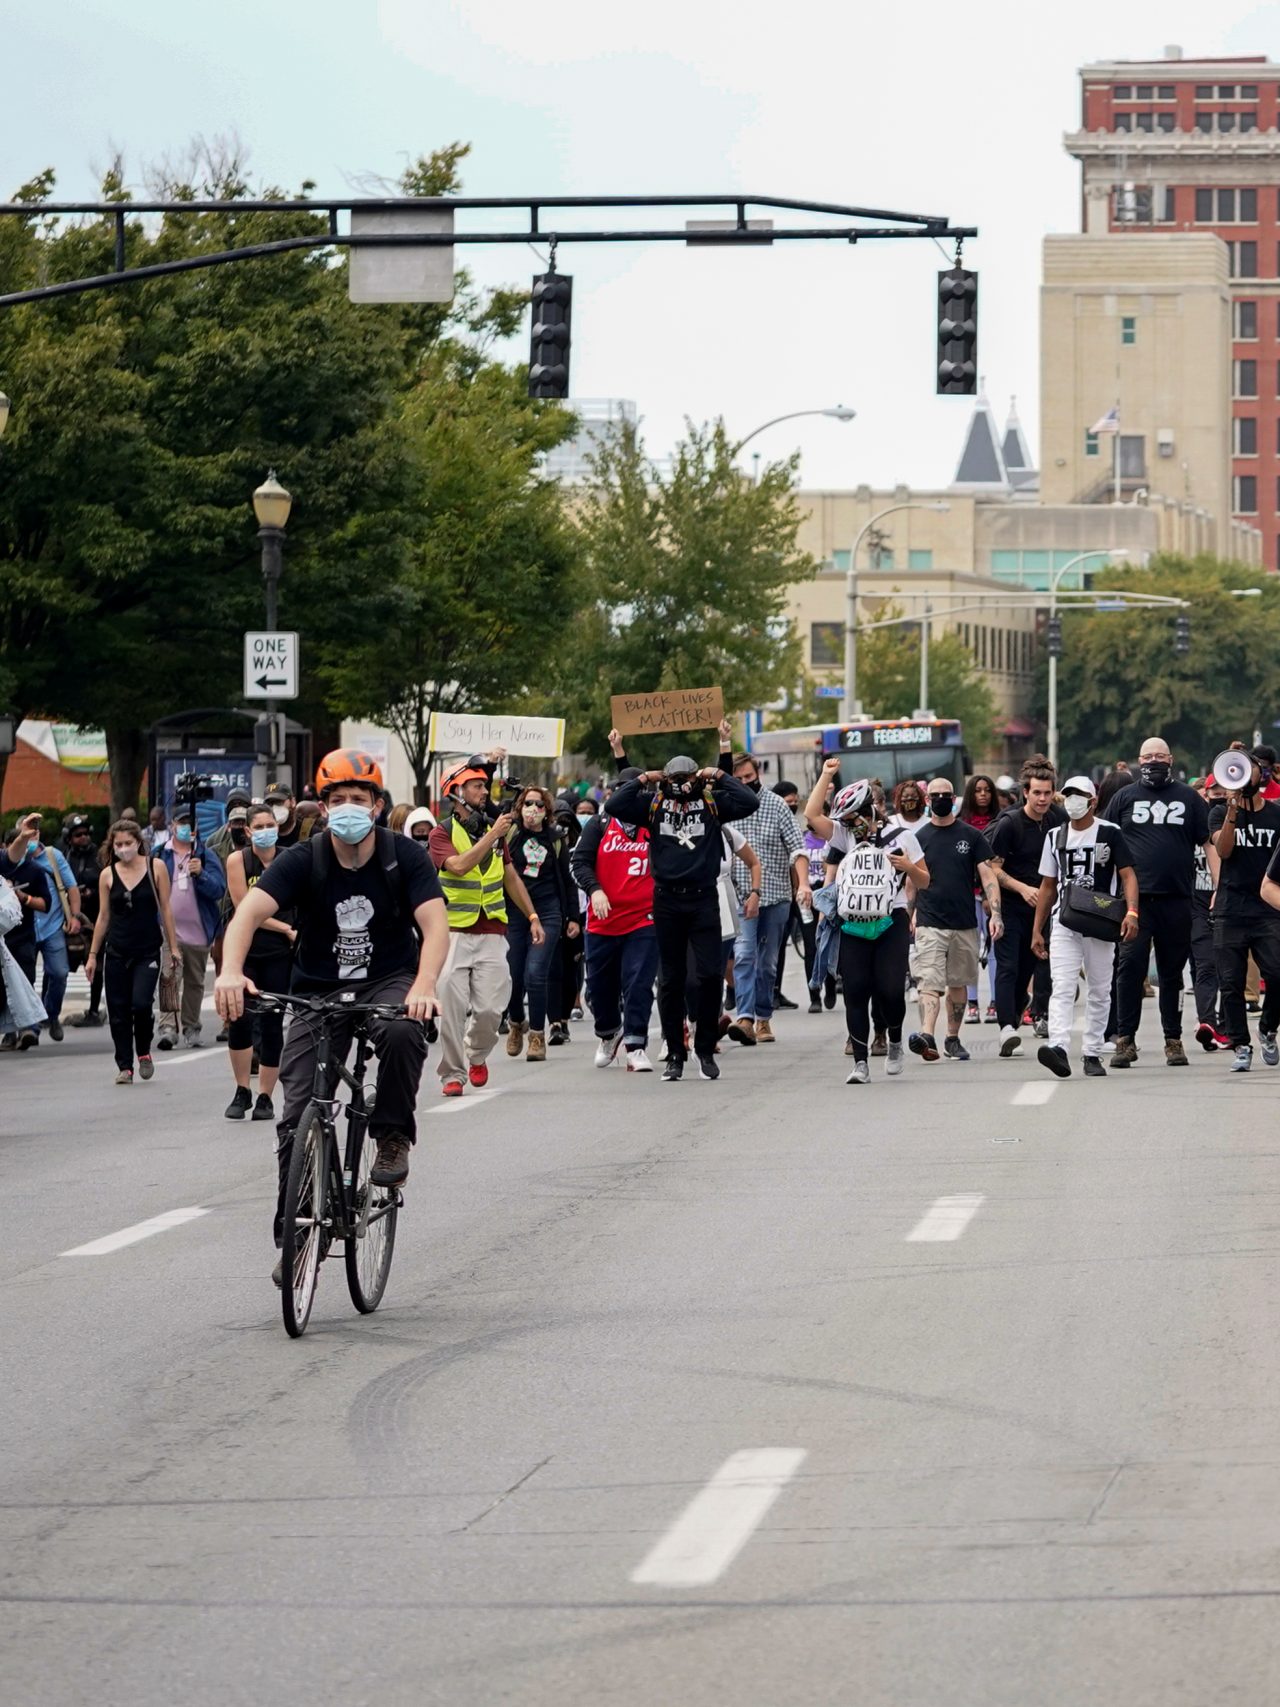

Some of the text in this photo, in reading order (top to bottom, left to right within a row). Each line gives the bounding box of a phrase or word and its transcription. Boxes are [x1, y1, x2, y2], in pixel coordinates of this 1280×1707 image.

[254, 639, 287, 652] ONE
[253, 656, 287, 669] WAY
[624, 692, 714, 712] BLACK LIVES
[639, 708, 713, 728] MATTER!
[443, 719, 545, 744] Say Her Name
[846, 727, 932, 747] 23 FEGENBUSH
[603, 834, 650, 853] Sixers
[627, 857, 649, 876] 21
[854, 854, 884, 870] NEW
[850, 874, 885, 886] YORK
[847, 893, 884, 911] CITY
[340, 948, 366, 956] LIVES
